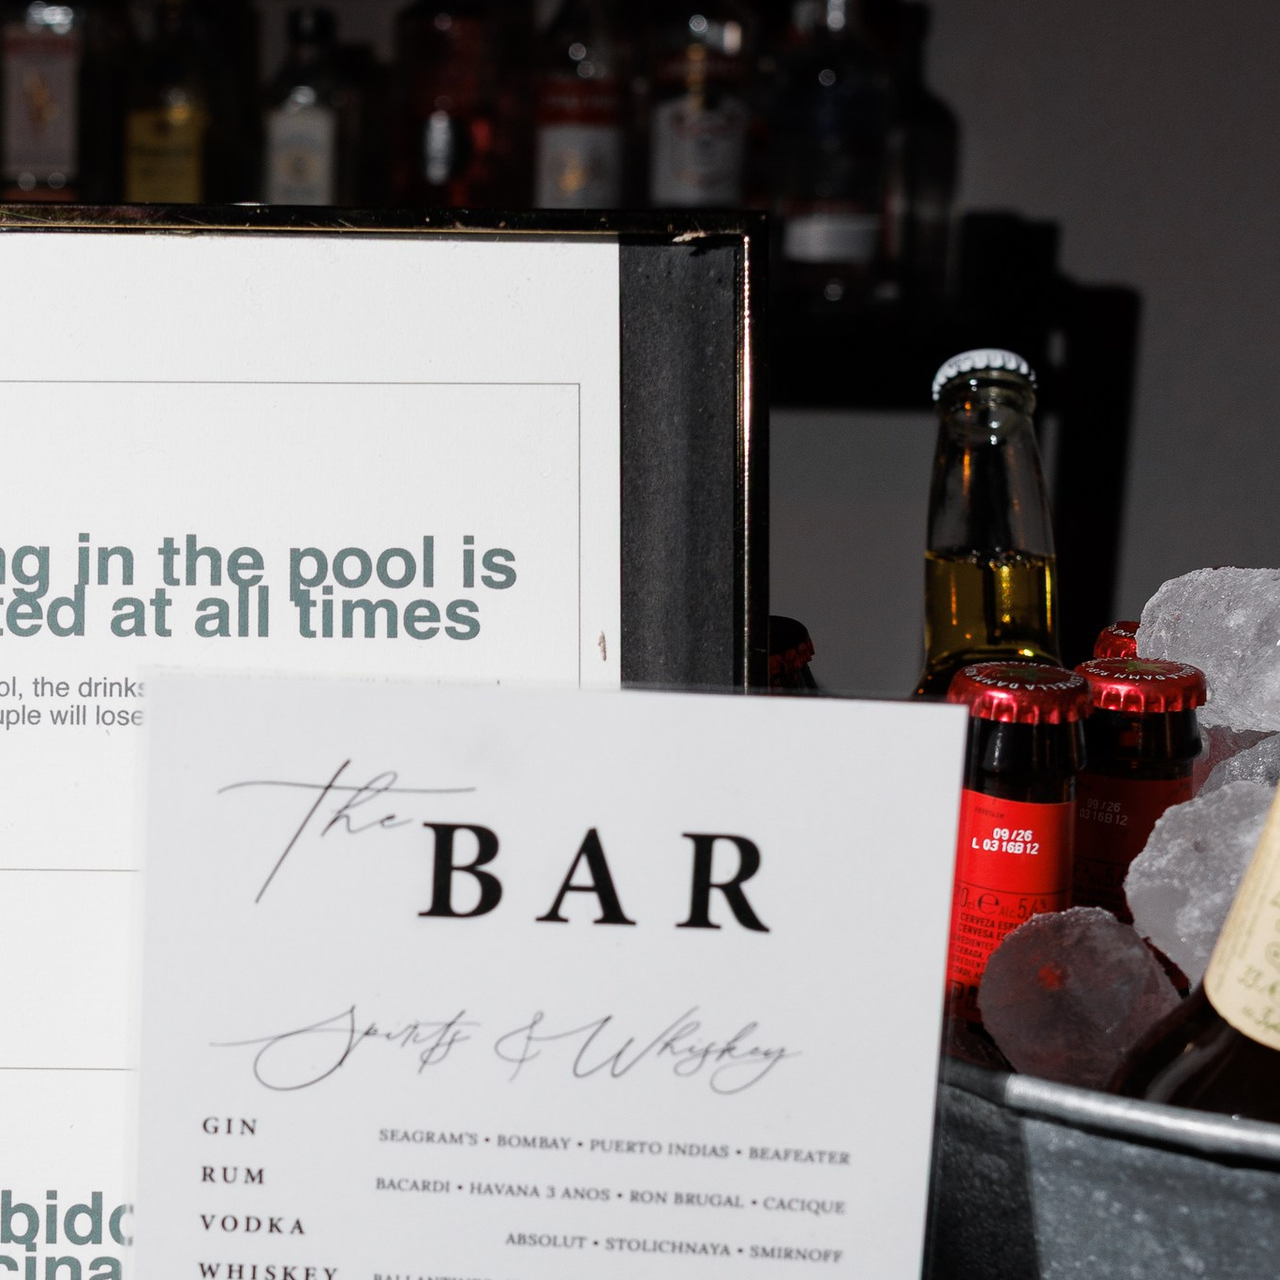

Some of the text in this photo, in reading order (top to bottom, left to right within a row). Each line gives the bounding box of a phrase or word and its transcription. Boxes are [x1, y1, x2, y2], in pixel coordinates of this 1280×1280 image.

[78, 533, 134, 585] in
[158, 534, 264, 587] the
[290, 535, 434, 601] pool
[463, 535, 517, 589] is
[110, 588, 172, 637] at
[194, 585, 269, 637] all
[294, 586, 480, 640] times
[32, 676, 69, 697] the
[49, 704, 87, 726] will
[972, 838, 980, 849] L
[417, 821, 771, 933] BAR
[958, 922, 994, 939] CERVESA
[960, 913, 995, 927] CERVEZA
[203, 1118, 256, 1135] GIN
[379, 1129, 850, 1165] SEAGRAM'S BOMBAY PUERTO INDIAS BEAFEATER
[202, 1166, 263, 1184] RUM
[376, 1177, 450, 1193] BACARDI
[470, 1182, 540, 1198] HAVANA
[546, 1186, 556, 1199] 3
[630, 1190, 667, 1204] RON
[674, 1192, 743, 1208] BRUGAL
[763, 1197, 844, 1216] CACIQUE
[201, 1214, 304, 1234] VODKA
[506, 1233, 842, 1263] ABSOLUT STOLICHNAYA SMIRNOFF
